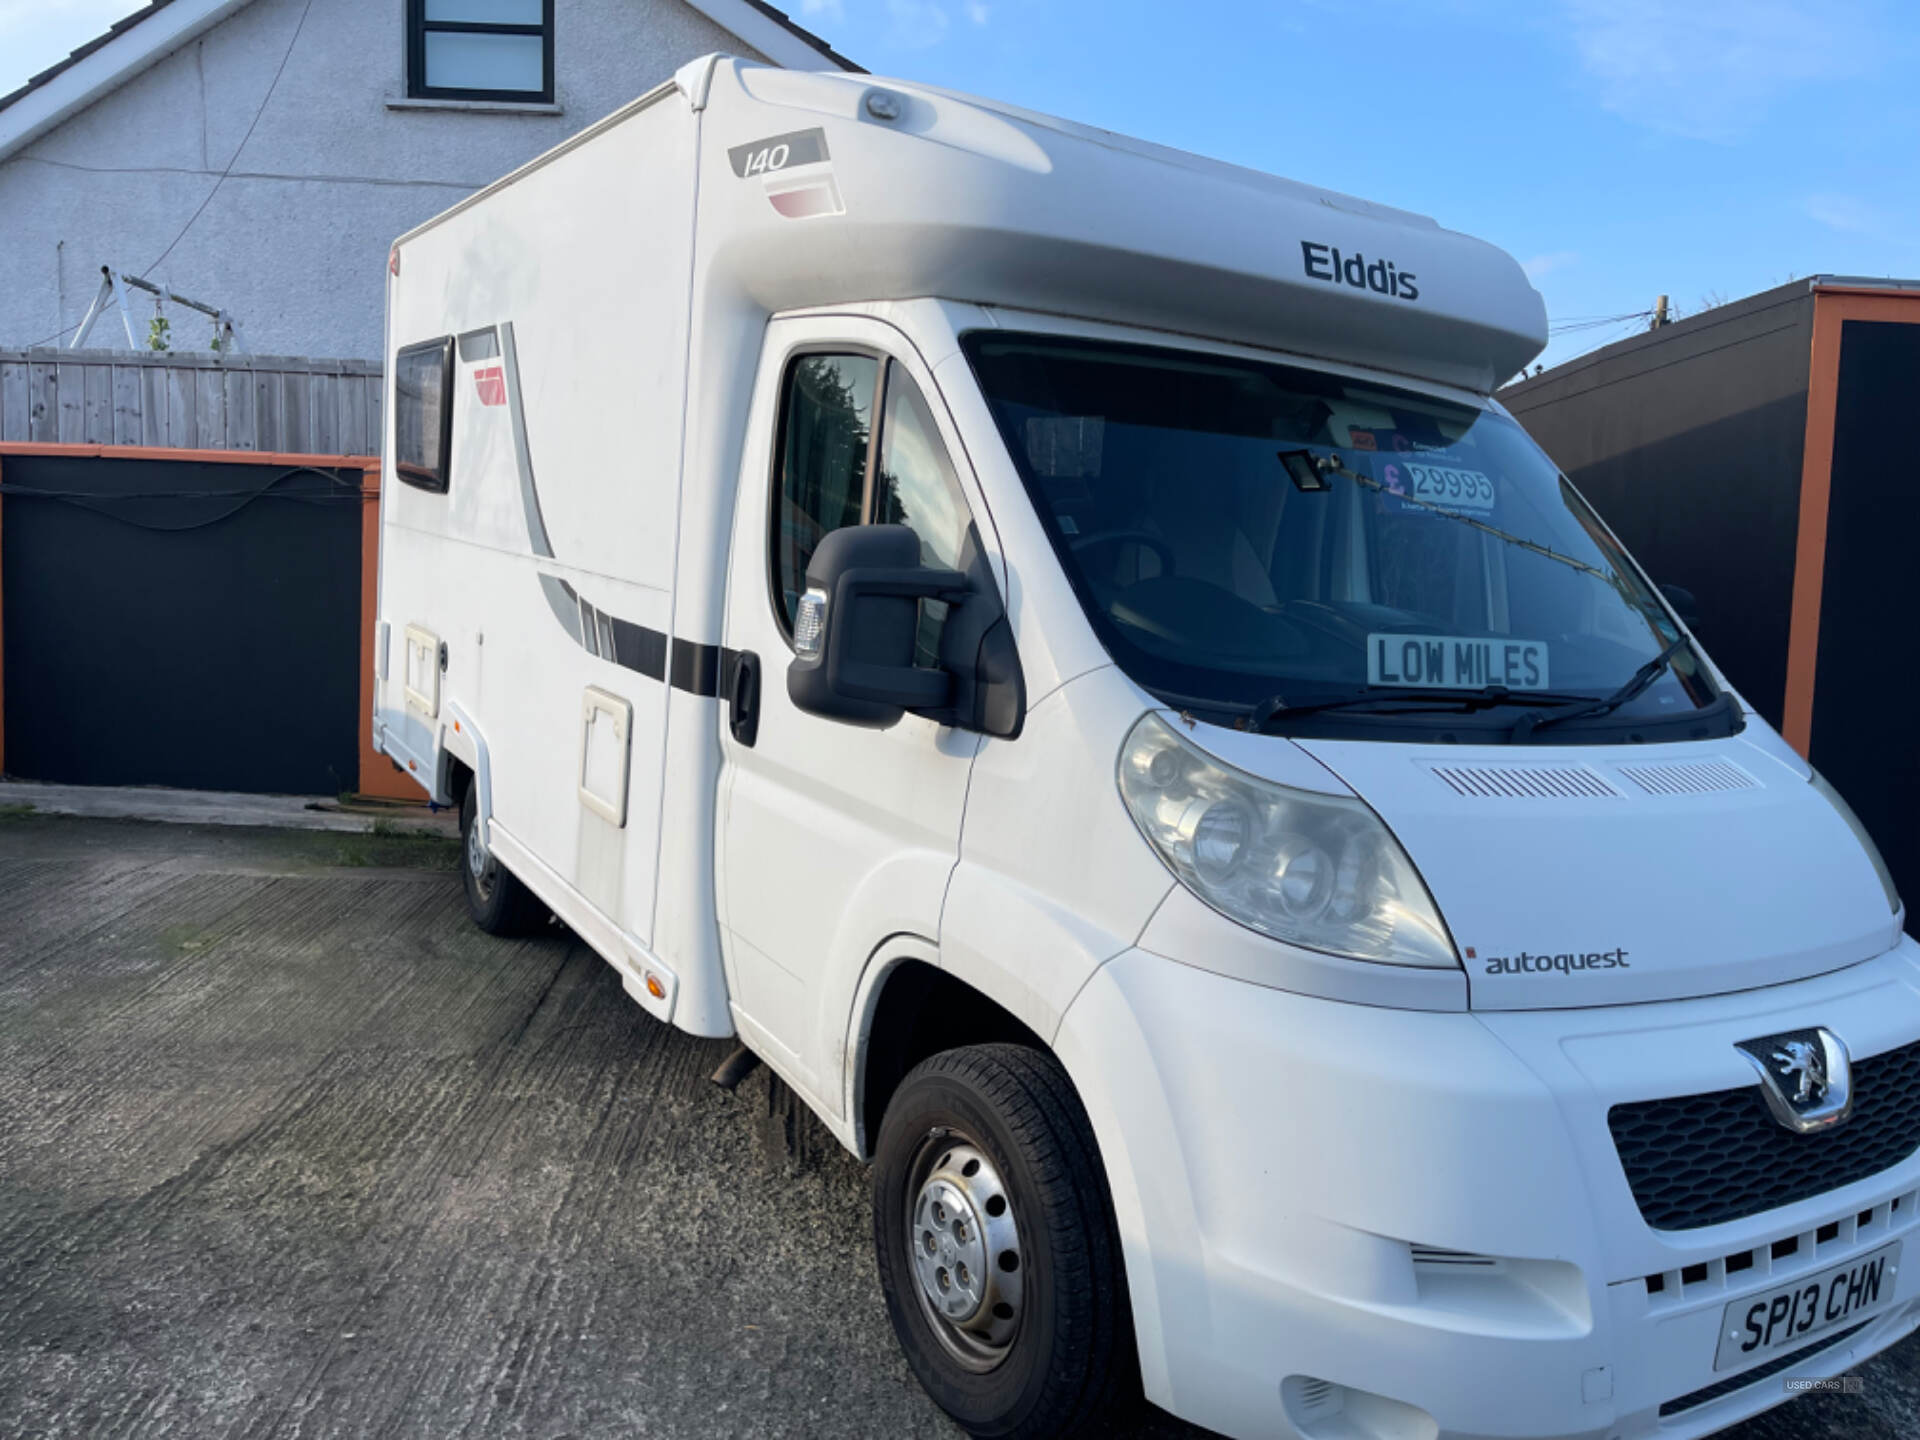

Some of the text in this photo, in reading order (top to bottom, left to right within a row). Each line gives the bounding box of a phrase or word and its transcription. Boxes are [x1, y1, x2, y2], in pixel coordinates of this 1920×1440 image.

[744, 144, 790, 177] 140
[1301, 240, 1419, 301] Elddis
[1378, 639, 1540, 686] LOW MILES
[1485, 948, 1630, 975] autoquest
[1741, 1257, 1885, 1352] SP13 CHN
